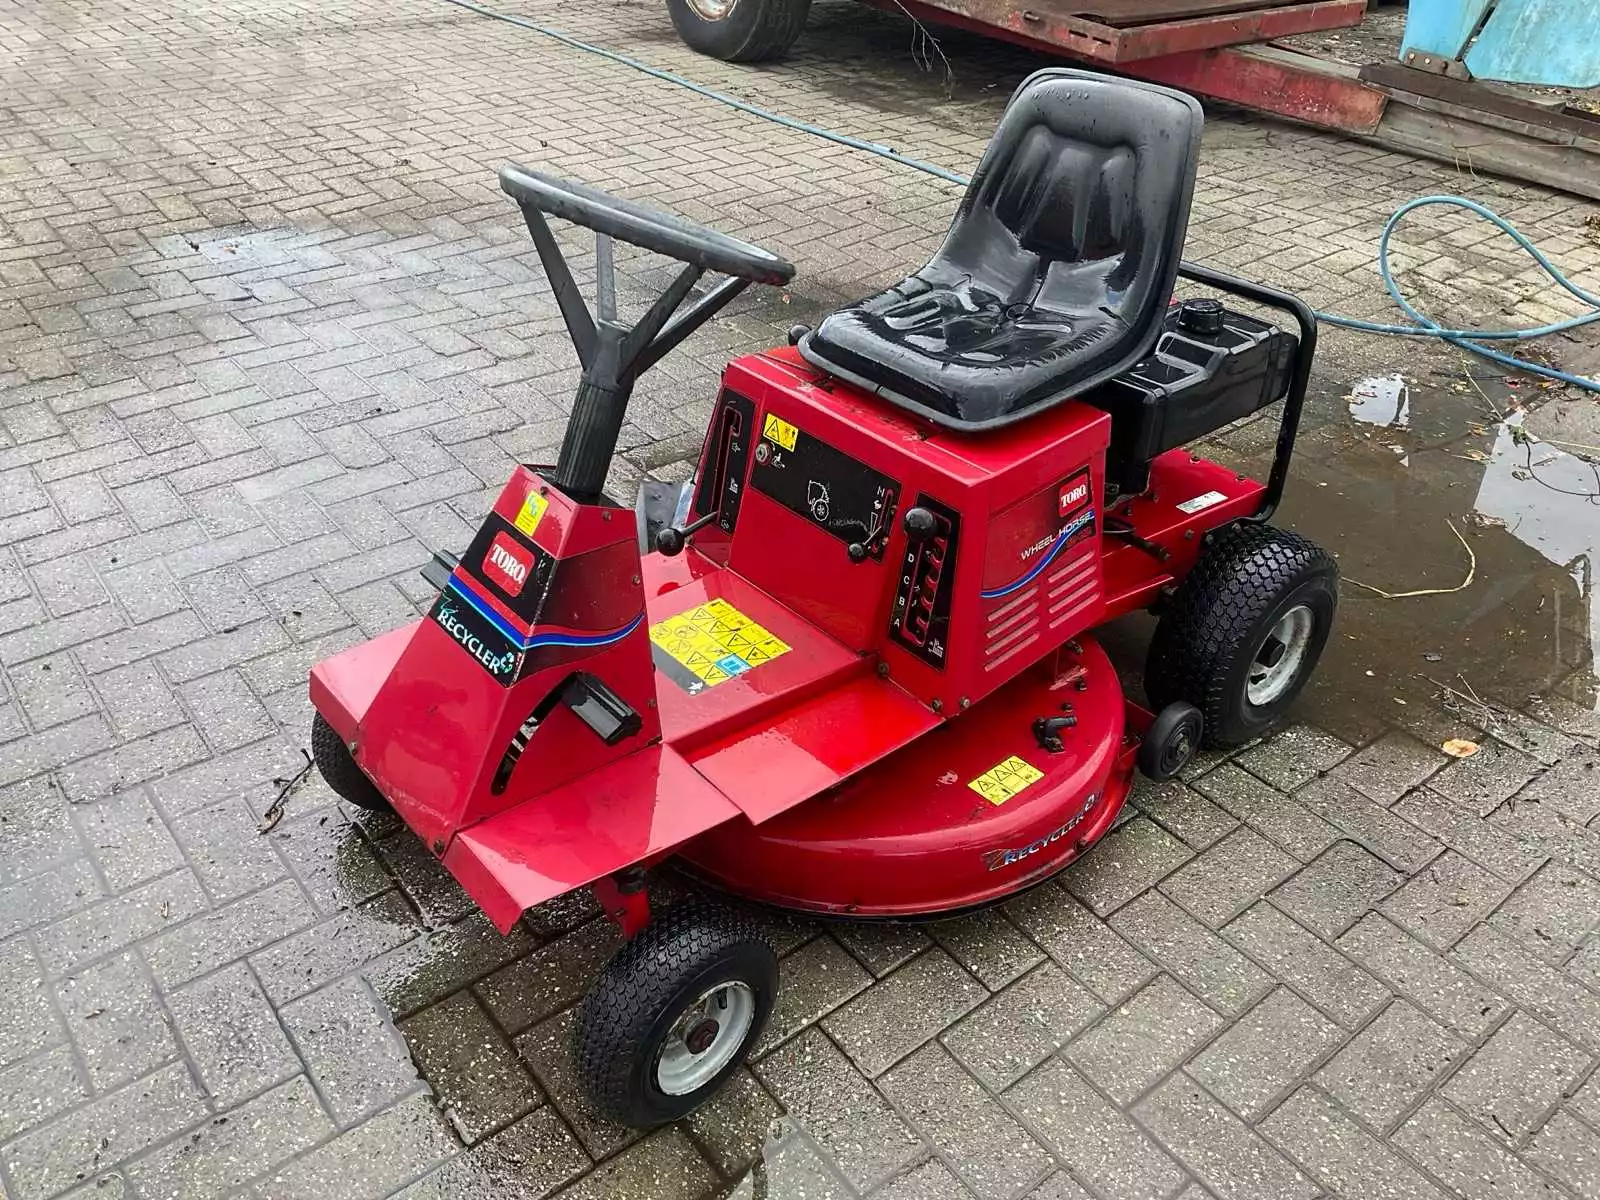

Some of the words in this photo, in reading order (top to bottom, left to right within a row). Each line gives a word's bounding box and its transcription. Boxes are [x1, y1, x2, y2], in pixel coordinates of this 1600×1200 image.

[1060, 484, 1087, 508] TORO
[1021, 534, 1056, 561] WHEEL
[1059, 511, 1095, 537] HORSE
[490, 543, 526, 584] TORO
[908, 553, 915, 563] D
[903, 575, 910, 585] C
[898, 596, 905, 606] B
[893, 617, 900, 628] A
[437, 609, 501, 675] RECYCLER
[1004, 812, 1084, 866] RECYCLER
